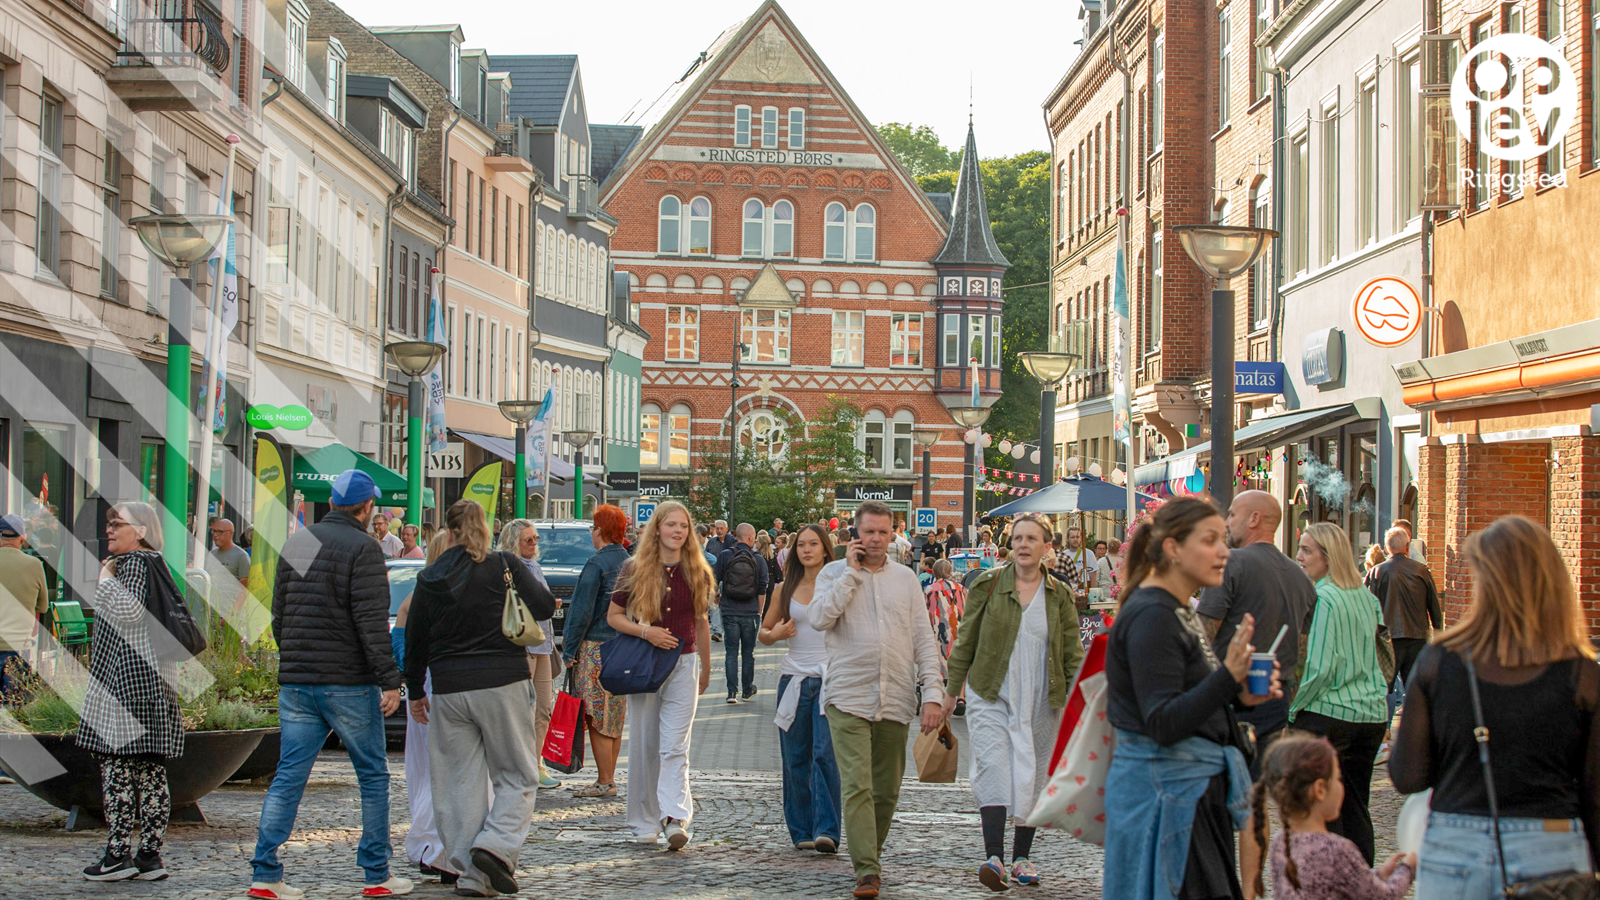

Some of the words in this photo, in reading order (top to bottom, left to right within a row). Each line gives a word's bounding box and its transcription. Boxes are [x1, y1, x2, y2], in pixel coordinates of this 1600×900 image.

[709, 148, 786, 163] RINGSTED
[793, 152, 833, 166] BØRS
[1234, 369, 1276, 386] matas
[251, 412, 274, 421] Louis
[275, 413, 307, 421] Nielsen
[639, 483, 670, 496] ormal
[855, 487, 894, 500] Normal
[639, 508, 654, 518] 20
[919, 513, 934, 524] 20
